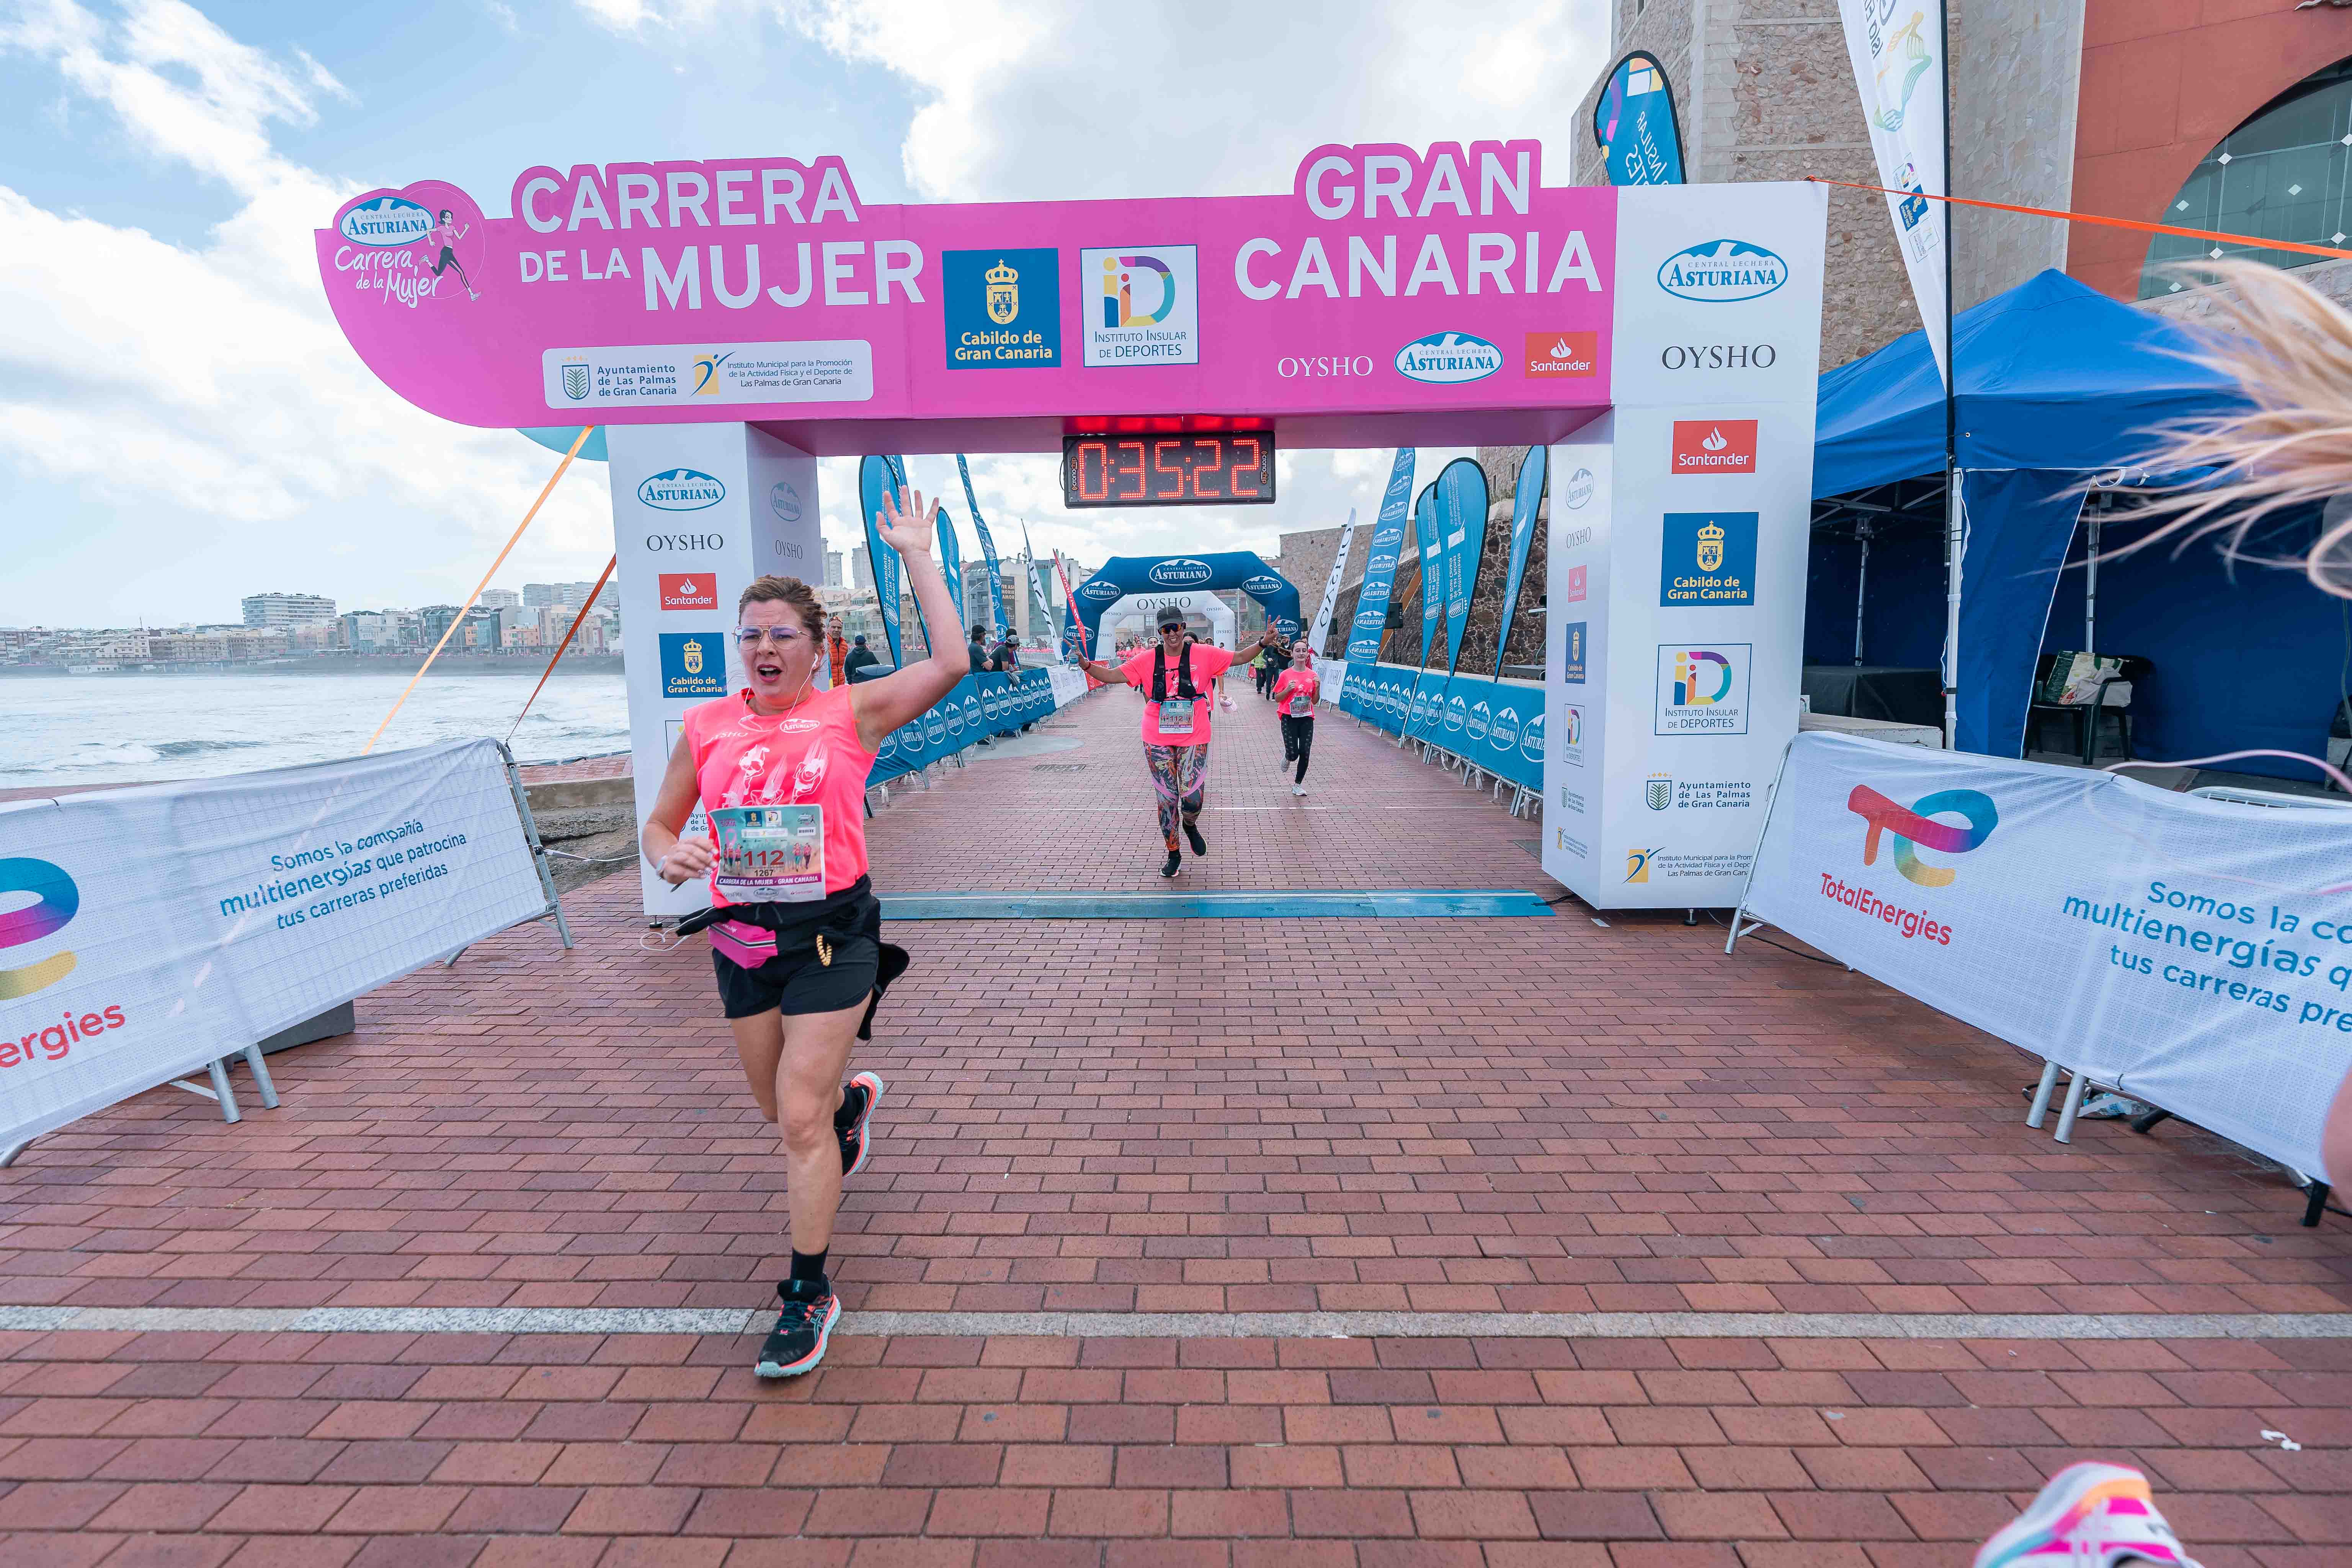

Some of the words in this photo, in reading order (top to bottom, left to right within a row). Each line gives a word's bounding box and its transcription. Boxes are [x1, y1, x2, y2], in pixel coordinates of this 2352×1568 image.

[1305, 151, 1530, 220] GRAN
[521, 167, 859, 233] CARRERA
[348, 217, 427, 235] ASTURIANA
[335, 245, 413, 271] Carrera
[1234, 230, 1603, 301] CANARIA
[520, 250, 568, 283] DE
[580, 247, 631, 280] LA
[642, 239, 925, 311] MUJER
[1667, 264, 1777, 287] ASTURIANA
[356, 271, 370, 289] de
[374, 271, 384, 289] la
[383, 265, 444, 309] Mujer
[961, 330, 1019, 345] Cabildo
[1023, 330, 1042, 344] de
[1095, 331, 1143, 342] INSTITUTO
[1147, 330, 1186, 341] INSULAR
[955, 347, 991, 360] Gran
[995, 345, 1052, 359] Canaria
[1099, 349, 1111, 358] DE
[1115, 344, 1182, 357] DEPORTES
[1662, 345, 1776, 369] OYSHO
[1277, 356, 1374, 377] OYSHO
[1403, 351, 1494, 371] ASTURIANA
[1530, 359, 1590, 373] Santander
[598, 364, 675, 376] Ayuntamiento
[814, 369, 841, 377] Deporte
[598, 377, 610, 385] de
[640, 375, 676, 384] Palmas
[599, 387, 611, 396] de
[613, 388, 637, 396] Gran
[640, 386, 676, 395] Canaria
[1679, 453, 1749, 466] Santander
[645, 485, 719, 501] ASTURIANA
[1568, 483, 1592, 503] ASTURIANA
[773, 494, 800, 514] ASTURIANA
[647, 534, 724, 551] OYSHO
[1566, 527, 1591, 548] OYSHO
[775, 540, 803, 560] OYSHO
[1154, 569, 1208, 580] ASTURIANA
[1674, 577, 1721, 588] Cabildo
[1724, 576, 1740, 587] de
[1245, 582, 1279, 590] ASTURIANA
[1668, 589, 1697, 599] Gran
[1700, 588, 1748, 599] Canaria
[665, 596, 712, 605] Santander
[1137, 597, 1191, 610] OYSHO
[1665, 708, 1704, 717] INSTITUTO
[1706, 707, 1738, 716] INSULAR
[926, 723, 945, 738] ASTURIANA
[1491, 721, 1515, 742] ASTURIANA
[1681, 719, 1734, 728] DEPORTES
[1679, 781, 1751, 791] Ayuntamiento
[271, 845, 334, 872] Somos
[335, 840, 353, 856] la
[357, 819, 424, 851] compañía
[744, 850, 784, 866] 112
[220, 858, 371, 917] multienergías
[376, 850, 404, 871] que
[407, 832, 467, 864] patrocina
[277, 909, 305, 930] tus
[310, 886, 375, 919] carreras
[379, 862, 448, 898] preferidas
[1820, 873, 1953, 946] TotalEnergies
[2148, 881, 2254, 924] Somos
[2270, 906, 2300, 933] la
[2063, 896, 2321, 977] multienergías
[2111, 945, 2153, 974] tus
[2163, 965, 2290, 1013] carreras
